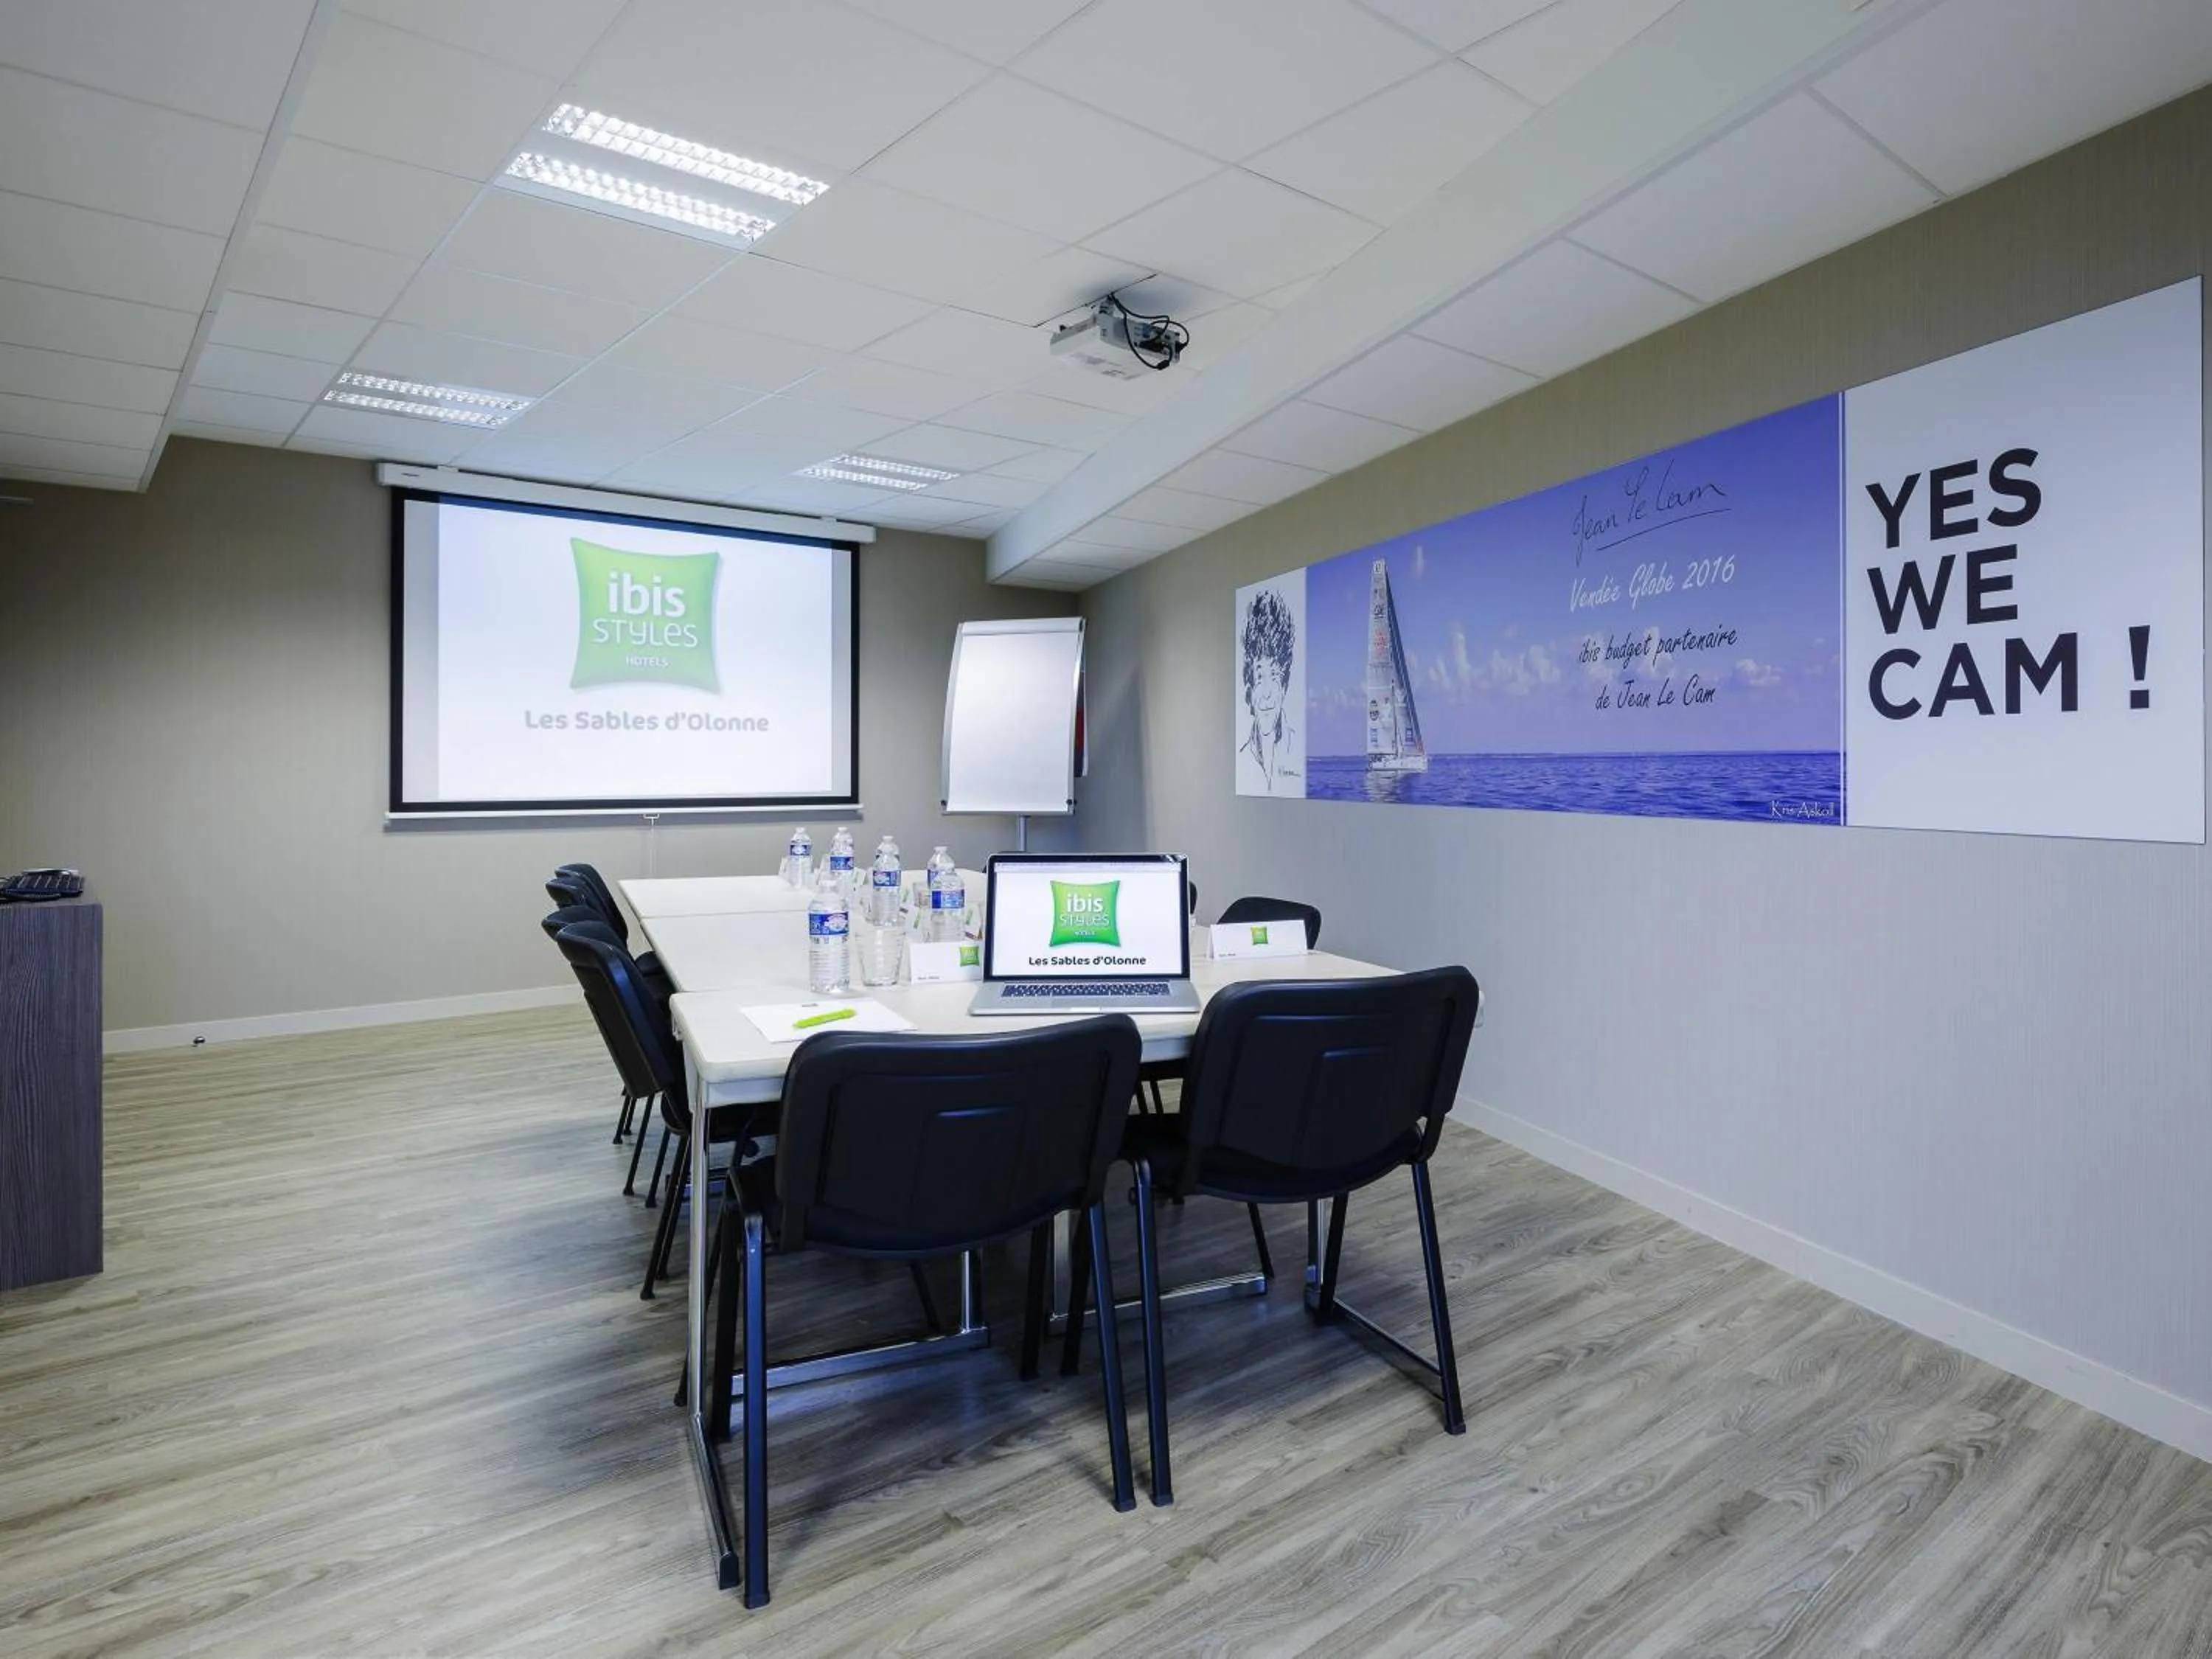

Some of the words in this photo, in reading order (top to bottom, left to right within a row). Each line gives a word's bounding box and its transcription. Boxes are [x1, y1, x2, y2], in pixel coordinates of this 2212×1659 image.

[1865, 448, 2042, 549] YES
[1571, 495, 1619, 567] Jean
[608, 570, 686, 618] ibis
[1570, 571, 1621, 613] Vendée
[1629, 561, 1675, 609] Globe
[1683, 554, 1735, 589] 2016
[1866, 543, 2018, 635] WE
[1578, 638, 1601, 664] ibis
[1604, 631, 1652, 669] budget
[1653, 624, 1738, 667] partenaire
[1595, 685, 1610, 710] de
[1617, 680, 1650, 709] Jean
[1657, 678, 1674, 706] Le
[1683, 673, 1717, 704] Cam
[1868, 632, 2078, 720] CAM
[524, 710, 568, 729] Les
[574, 711, 658, 730] Sables
[664, 712, 770, 731] d'Olonne
[1067, 893, 1104, 912] ibis
[1029, 956, 1048, 965] Les
[1051, 956, 1091, 965] Sables
[1093, 956, 1147, 965] d'Olonne
